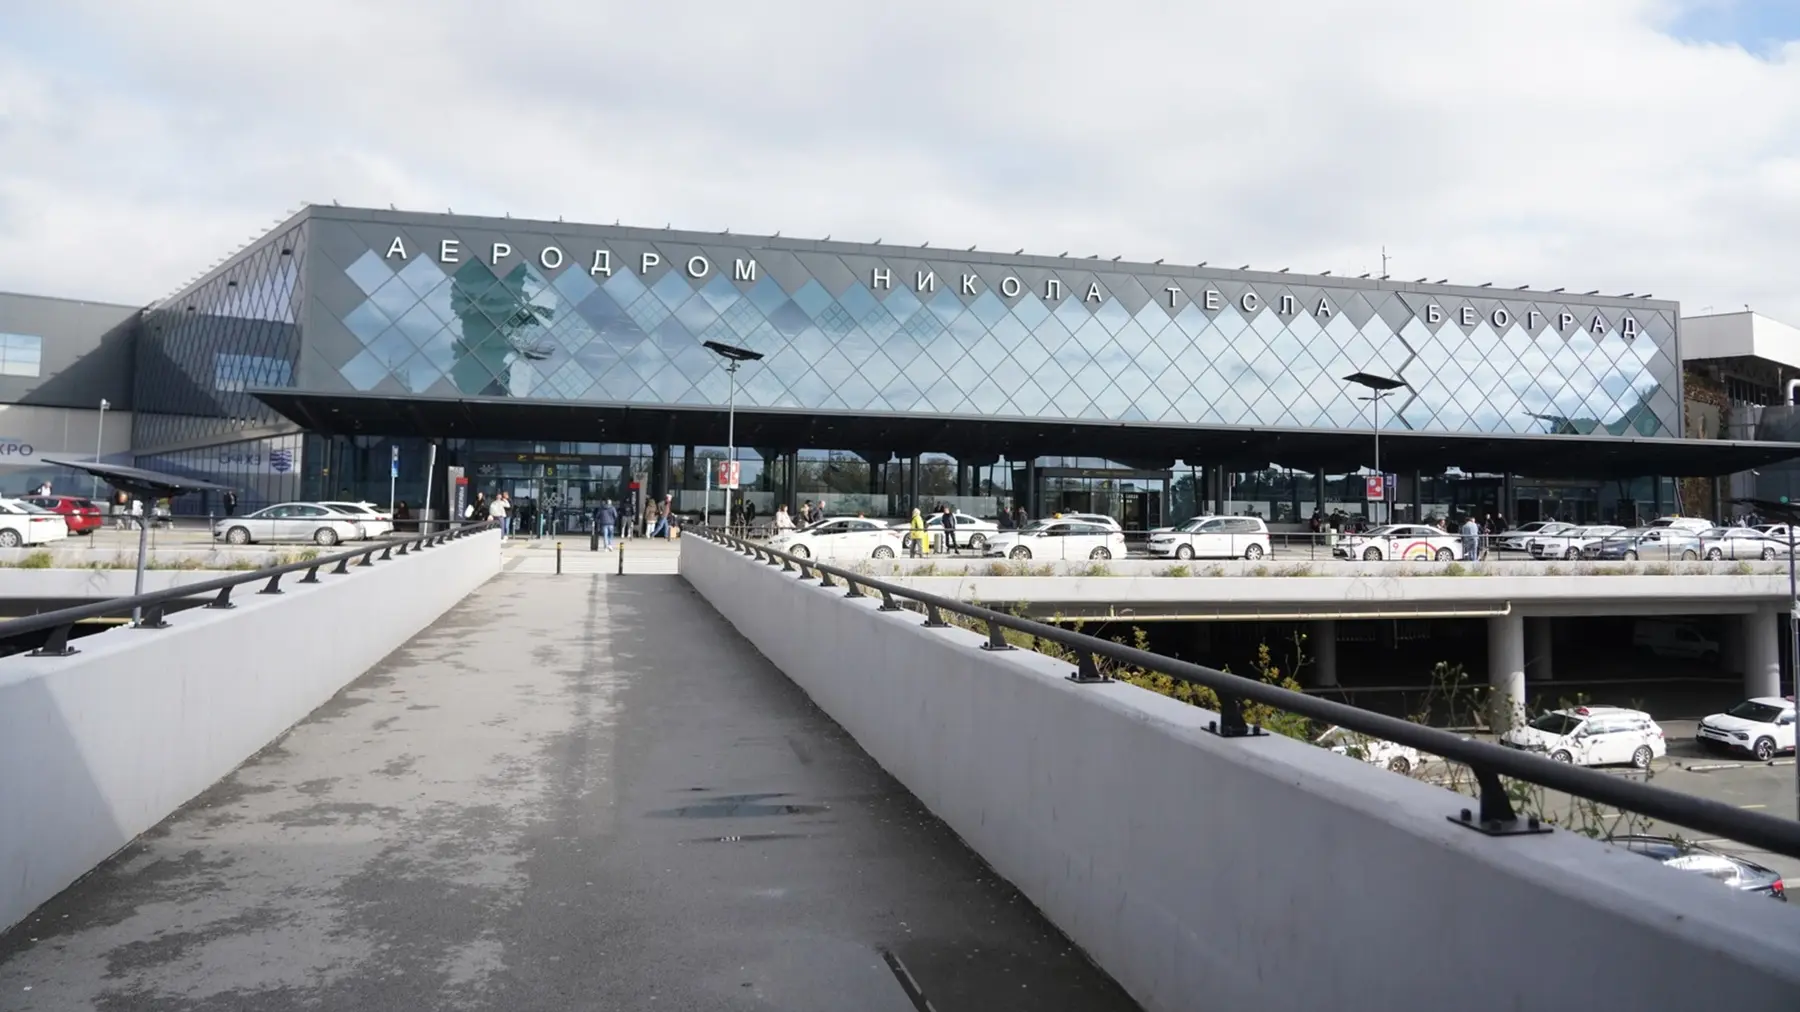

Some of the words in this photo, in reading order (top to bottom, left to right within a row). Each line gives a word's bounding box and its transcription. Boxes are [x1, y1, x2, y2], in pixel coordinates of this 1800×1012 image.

[386, 236, 757, 281] АЕРОДРОМ
[873, 268, 1103, 303] НИКОЛА
[1165, 288, 1331, 318] ТЕСЛА
[1426, 304, 1637, 339] БЕОГРАД
